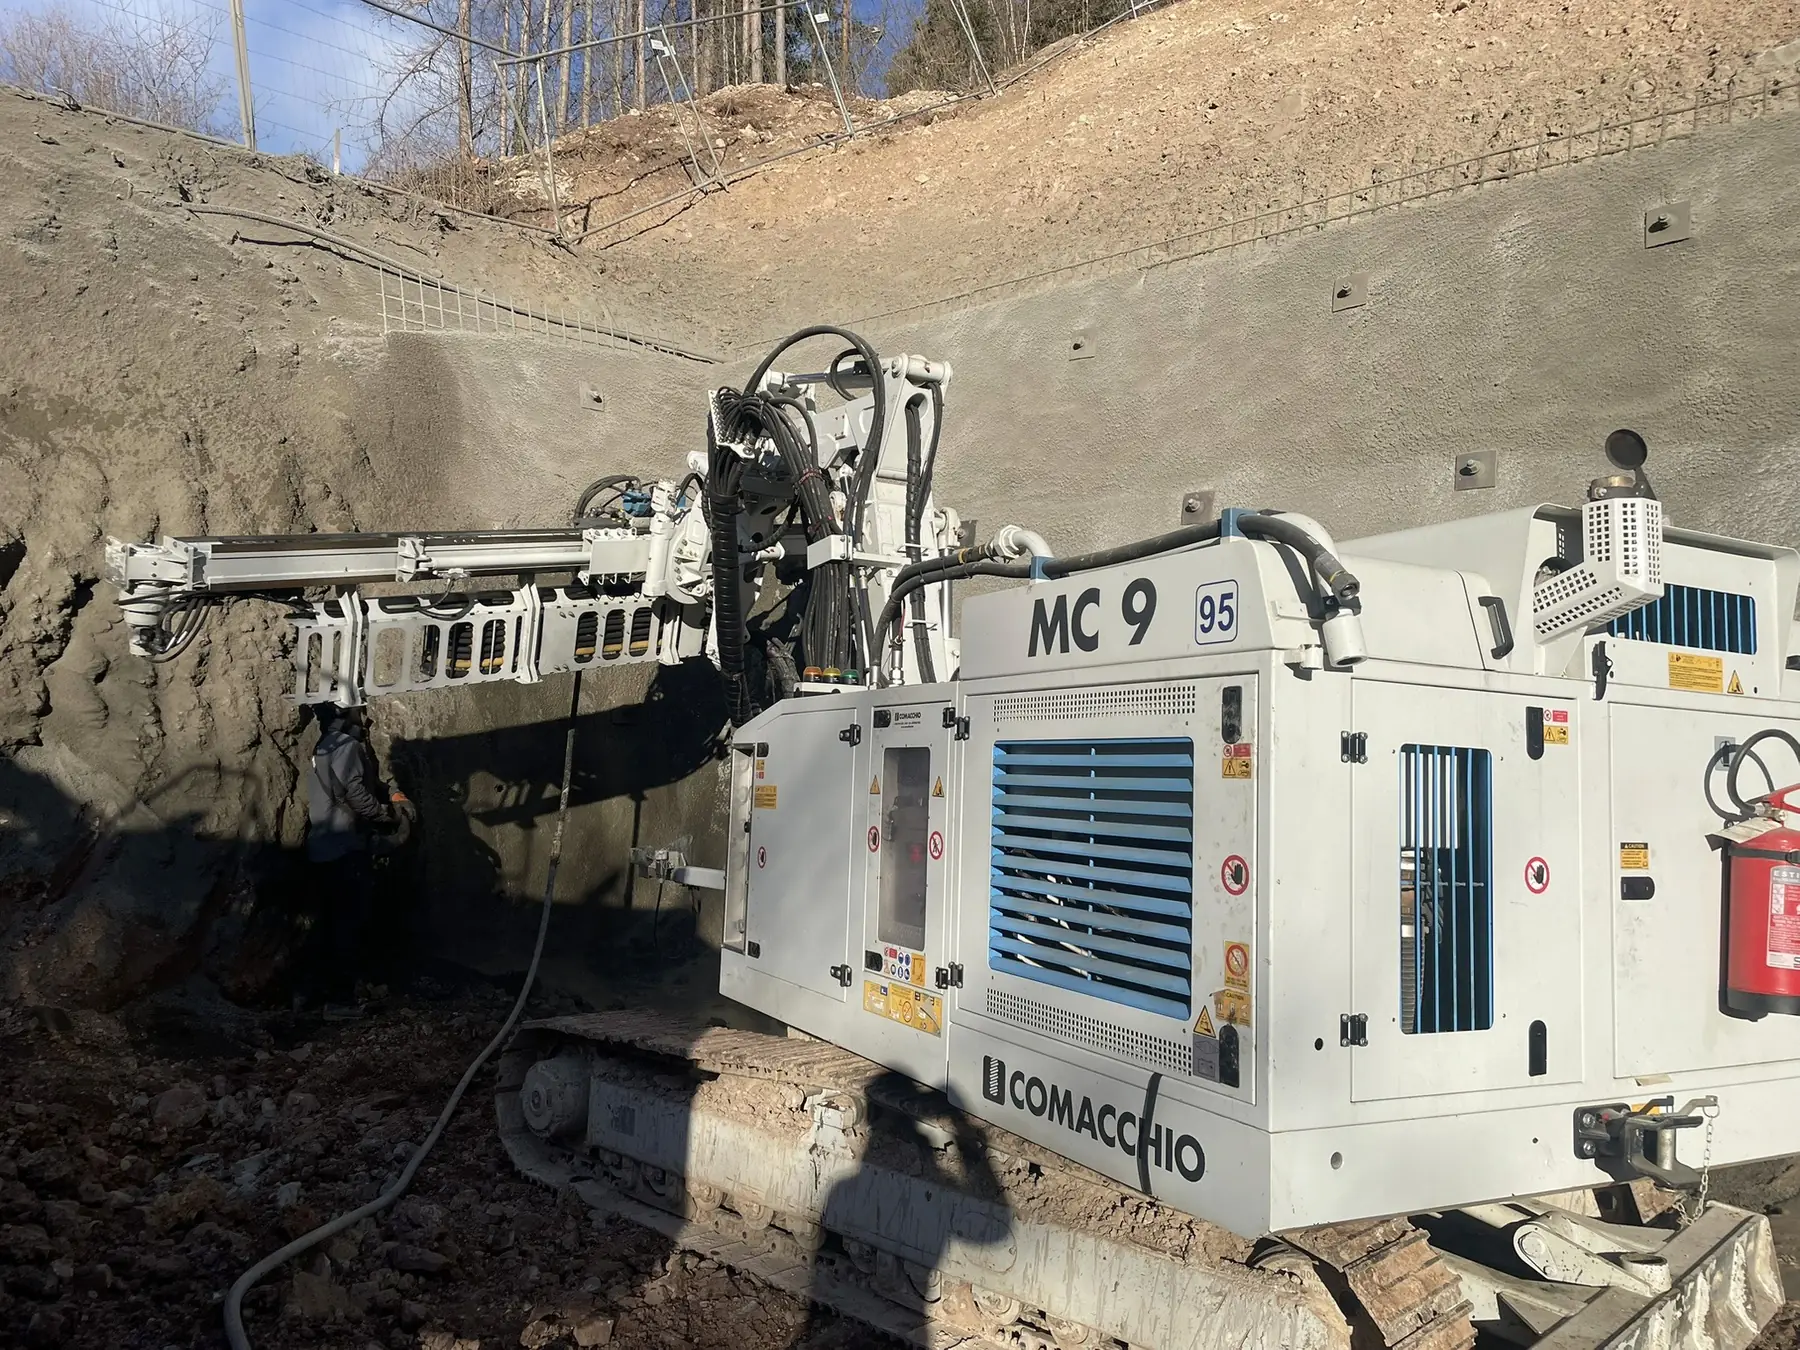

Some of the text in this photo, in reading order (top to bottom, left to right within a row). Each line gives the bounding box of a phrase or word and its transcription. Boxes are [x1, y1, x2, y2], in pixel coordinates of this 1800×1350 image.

[1028, 577, 1157, 657] MC 9
[1199, 592, 1234, 634] 95
[1009, 1070, 1206, 1183] COMACCHIO
